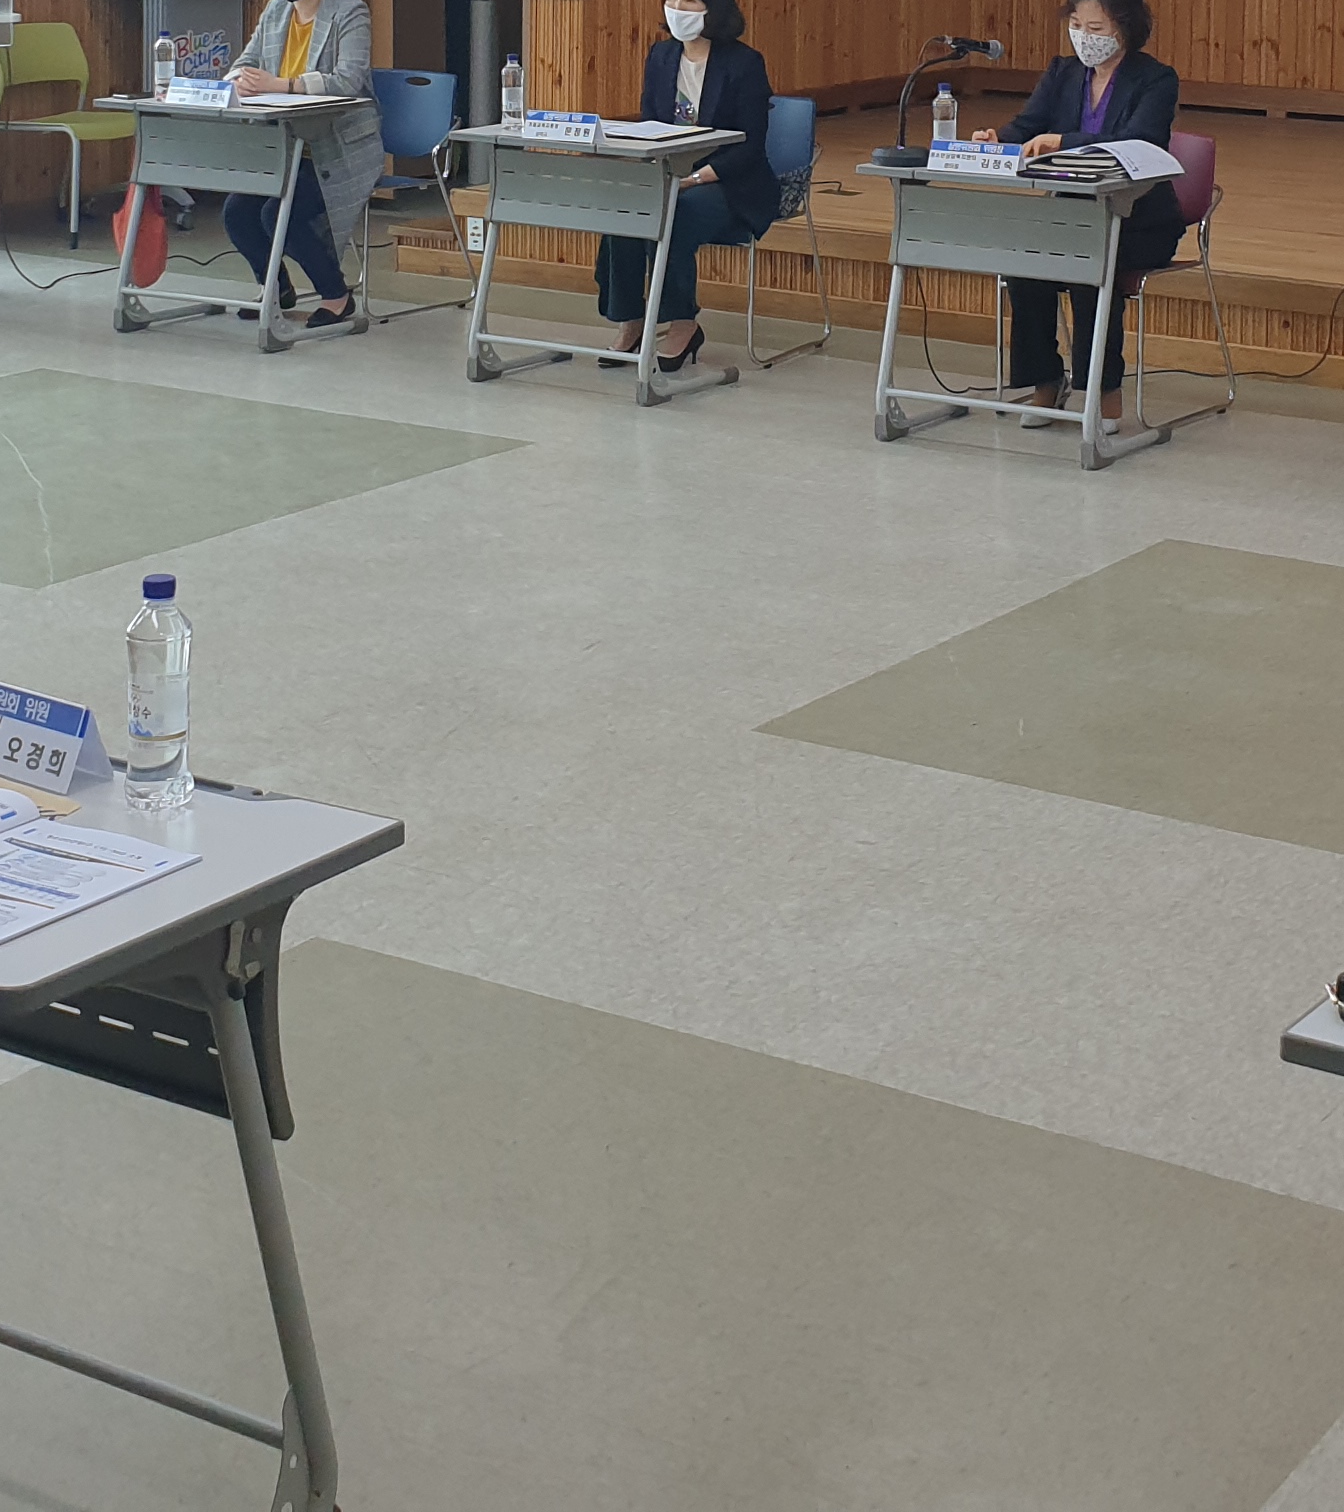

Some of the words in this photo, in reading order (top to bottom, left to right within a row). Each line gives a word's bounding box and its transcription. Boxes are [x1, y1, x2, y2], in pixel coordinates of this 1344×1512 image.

[174, 31, 211, 59] Blue
[182, 49, 212, 76] City
[24, 697, 51, 723] 위원
[2, 736, 67, 777] 오경희
